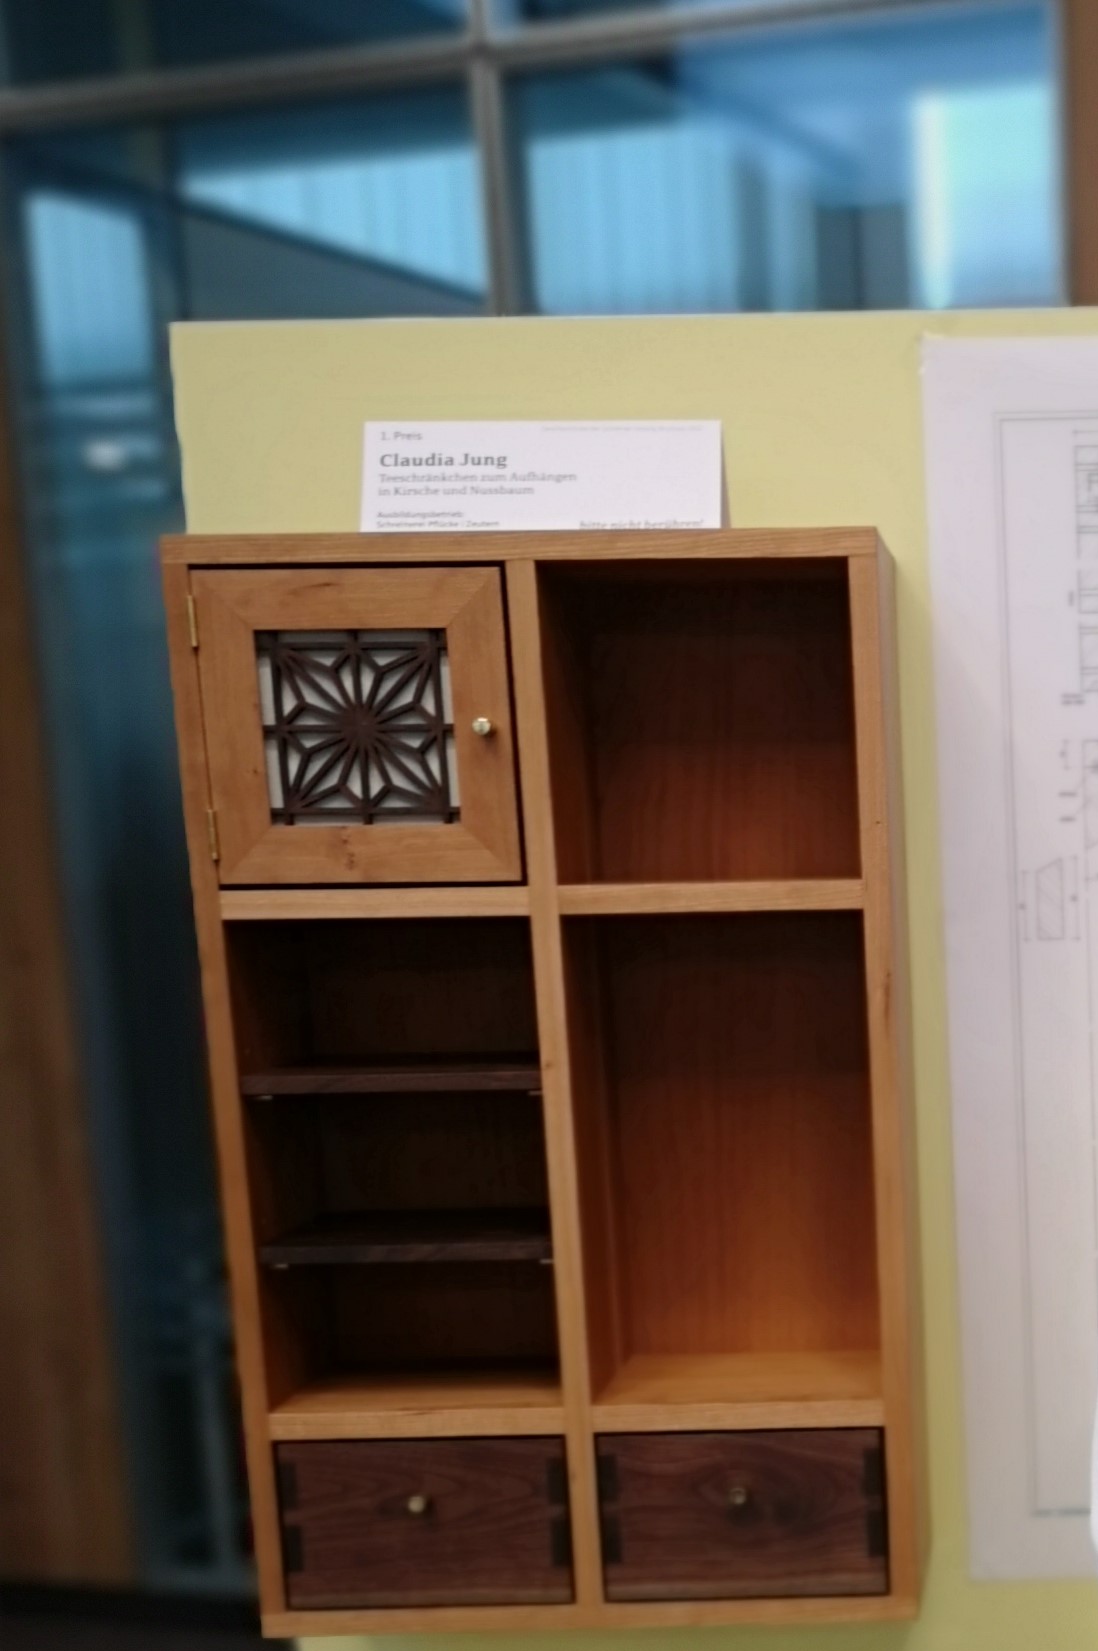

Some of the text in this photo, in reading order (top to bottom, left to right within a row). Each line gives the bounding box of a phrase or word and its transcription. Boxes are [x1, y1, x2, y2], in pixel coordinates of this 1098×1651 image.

[380, 431, 422, 441] 1. Preis
[379, 452, 508, 469] Claudia Jung
[378, 471, 578, 484] Teeschränkchen zum Aufhängen
[377, 484, 535, 497] in Kirsche und Nussbaum
